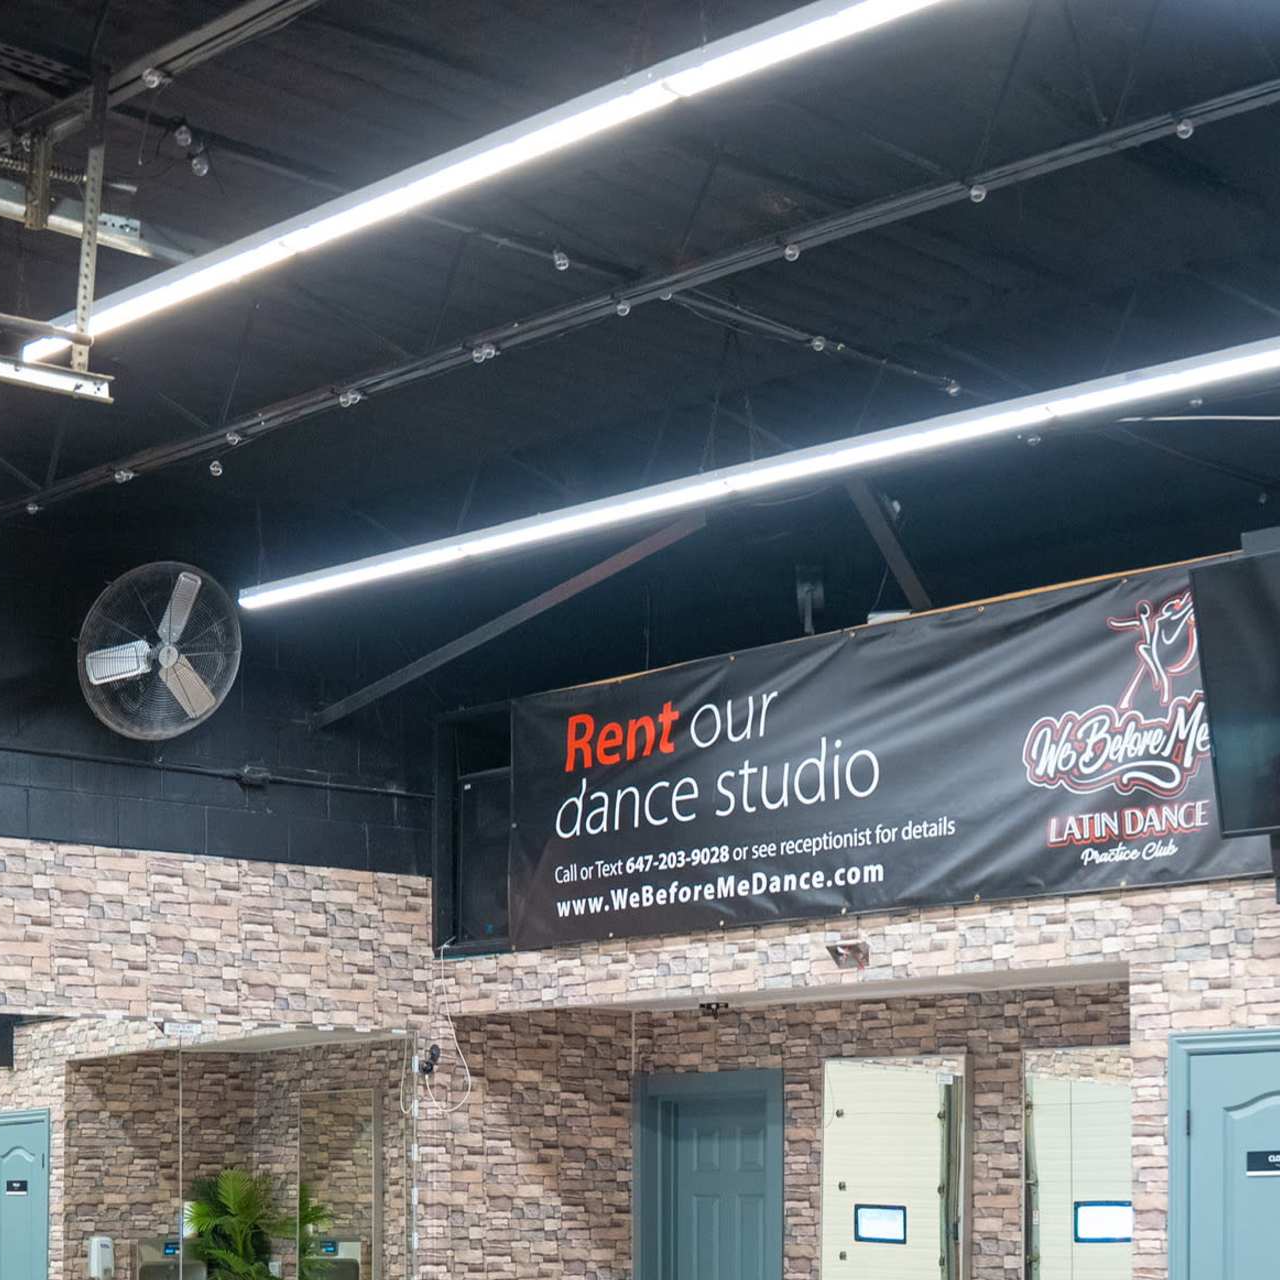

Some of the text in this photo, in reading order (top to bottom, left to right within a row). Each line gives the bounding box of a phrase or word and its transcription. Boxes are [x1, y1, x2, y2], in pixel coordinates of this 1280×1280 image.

[565, 691, 778, 773] Rent our
[1031, 701, 1211, 778] We Before Me
[555, 736, 880, 840] dance studio
[1049, 800, 1210, 844] LATIN DANCE
[554, 816, 956, 884] Call or Text 647-203-9028 or see receptionist for details
[1081, 840, 1178, 866] Practice Club
[557, 863, 884, 918] www.WeBeforeMeDance.com
